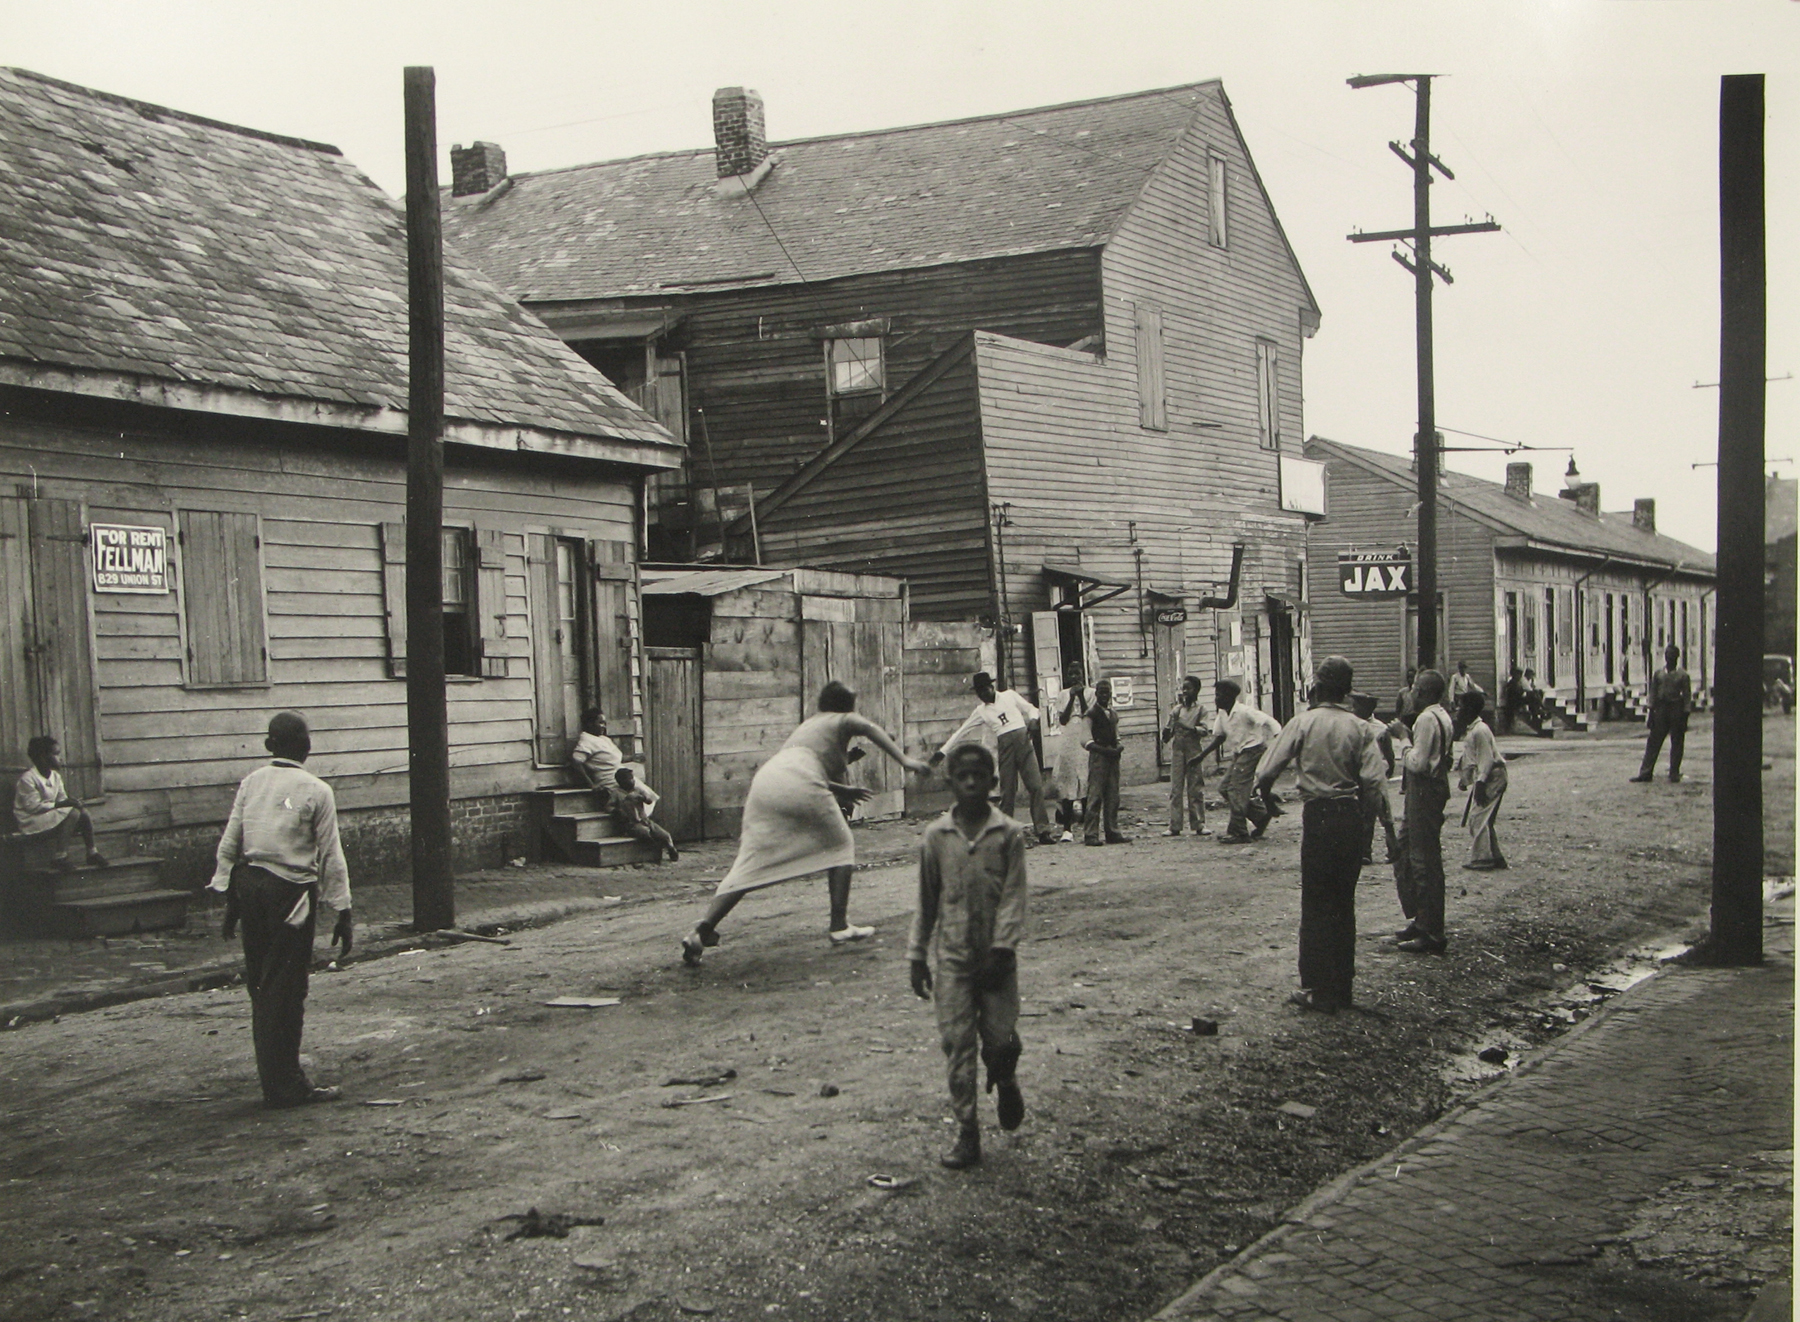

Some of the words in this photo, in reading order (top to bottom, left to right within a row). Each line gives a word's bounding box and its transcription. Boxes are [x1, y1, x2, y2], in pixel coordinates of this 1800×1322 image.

[96, 529, 127, 546] FOR
[130, 531, 162, 547] RENT
[97, 543, 163, 574] FELLMAN
[98, 573, 119, 585] 829
[120, 574, 150, 586] UNION
[151, 574, 163, 586] ST
[1344, 566, 1407, 592] JAX
